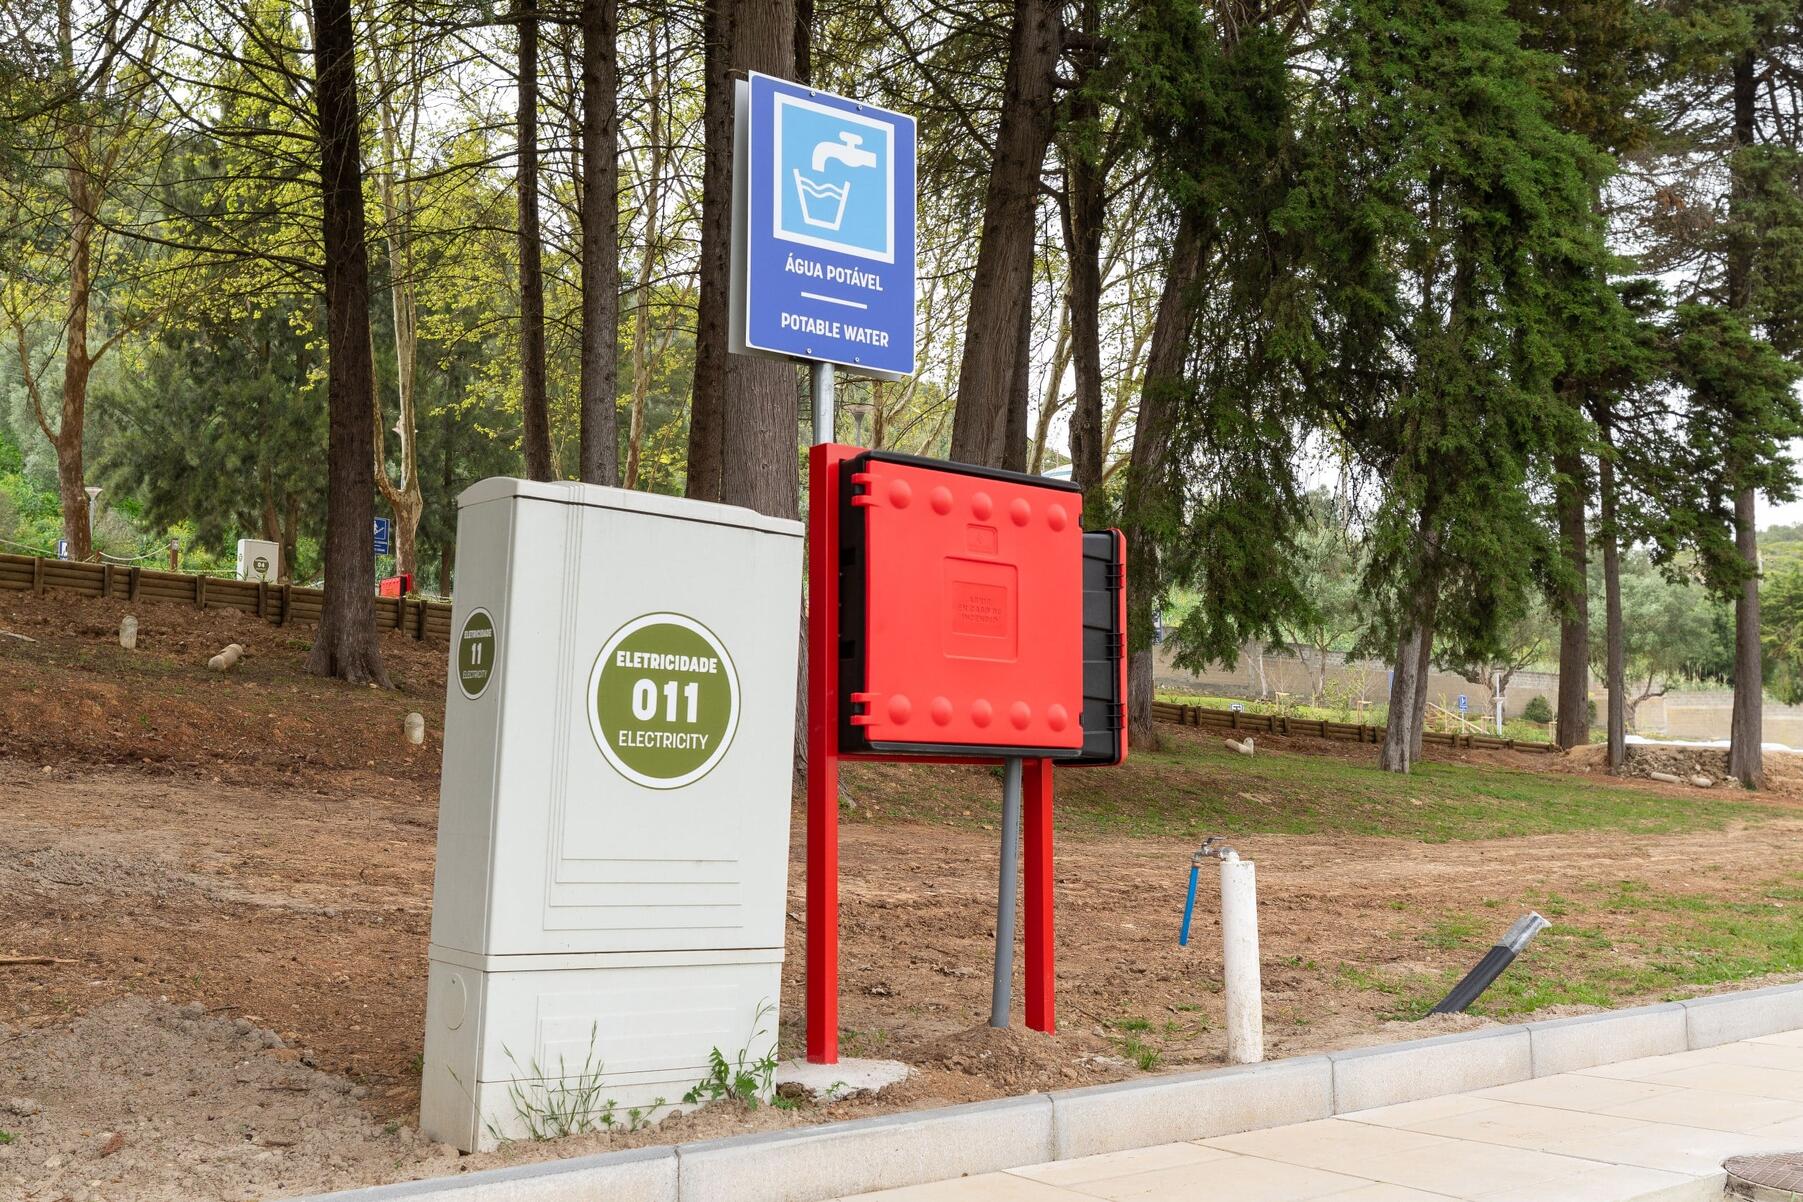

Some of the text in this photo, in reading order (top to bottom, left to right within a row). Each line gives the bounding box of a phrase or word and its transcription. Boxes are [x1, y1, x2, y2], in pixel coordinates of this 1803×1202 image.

[785, 252, 884, 291] ÁGUA POTÁVEL
[781, 312, 889, 347] POTABLE WATER
[471, 642, 482, 665] 11
[616, 650, 718, 674] ELETRICIDADE
[631, 678, 699, 723] 011
[618, 730, 709, 750] ELECTRICITY
